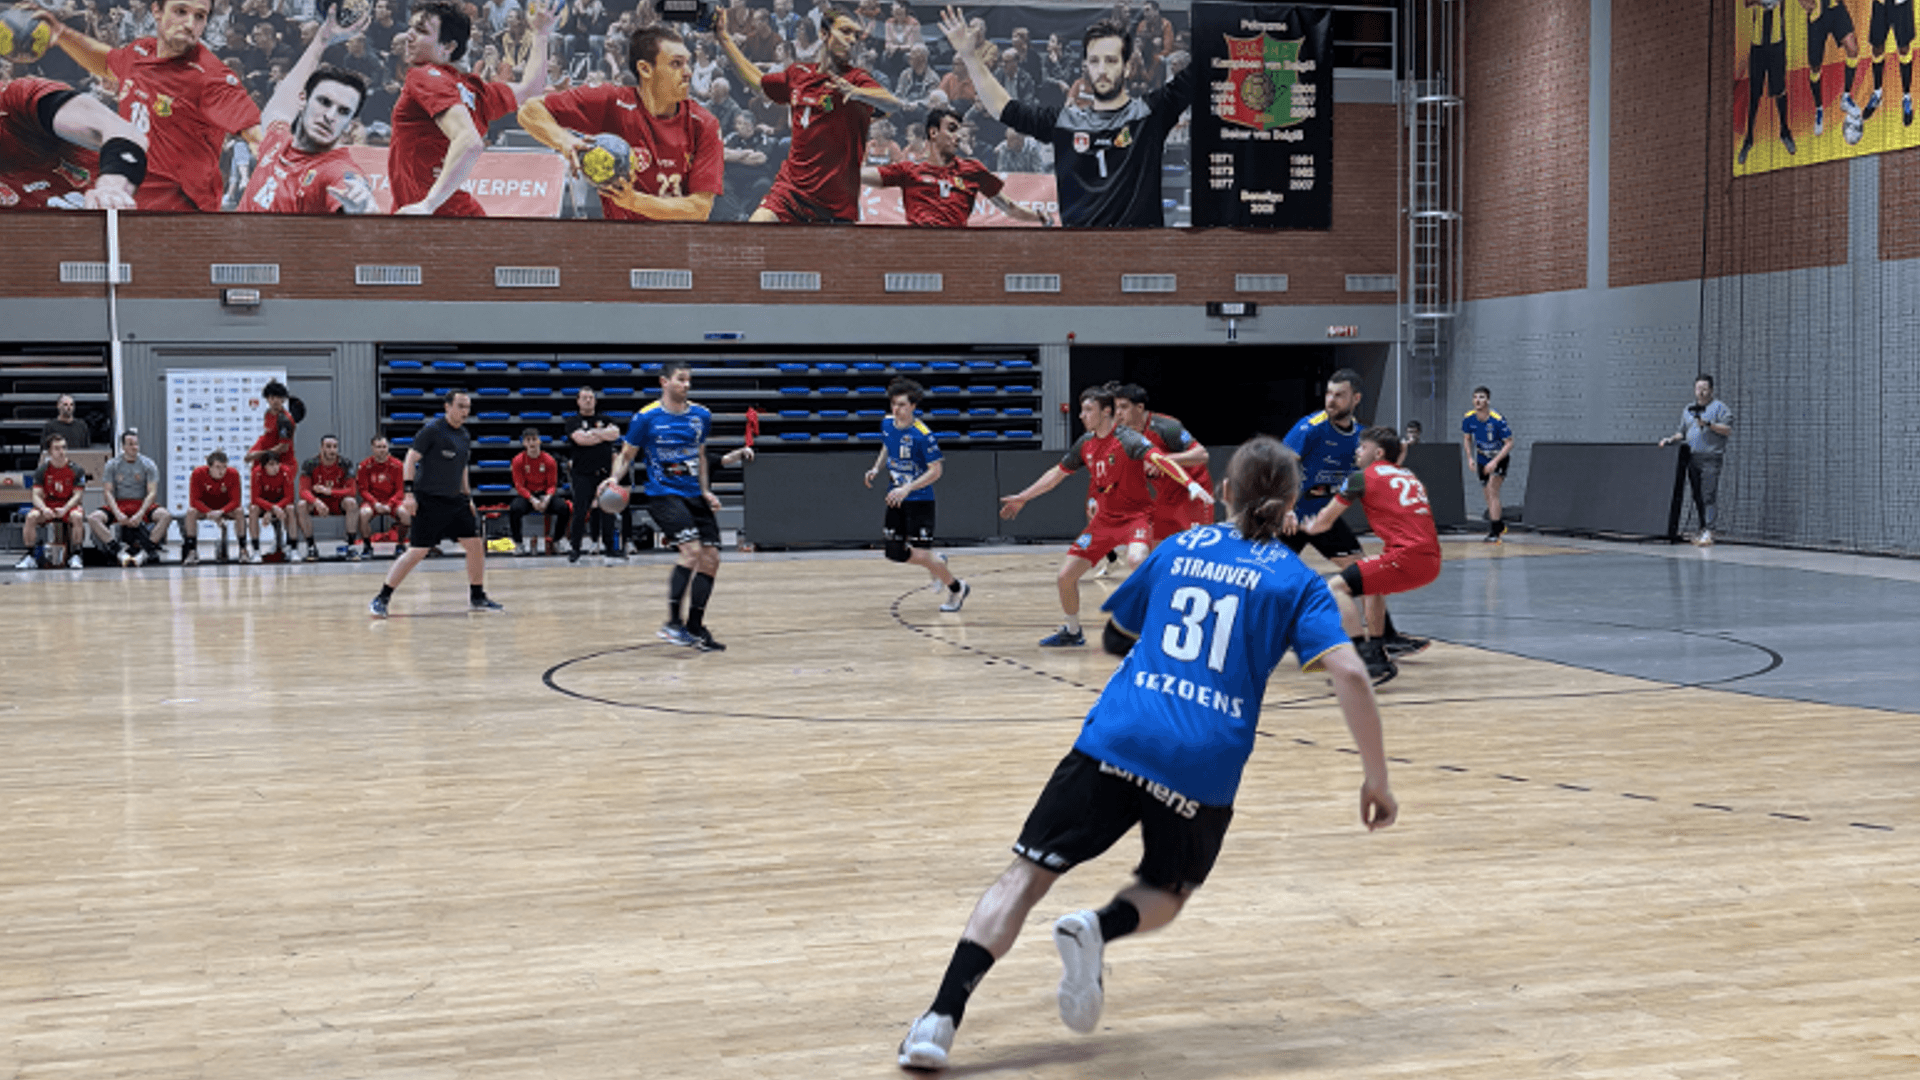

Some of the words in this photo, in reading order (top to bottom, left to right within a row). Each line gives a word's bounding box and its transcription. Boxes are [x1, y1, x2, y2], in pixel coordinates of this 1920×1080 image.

[1253, 131, 1271, 140] van
[1096, 150, 1108, 178] 1
[459, 178, 548, 197] WERPEN
[1390, 477, 1428, 506] 23
[1170, 556, 1262, 591] STRAUVEN
[1161, 586, 1240, 674] 31
